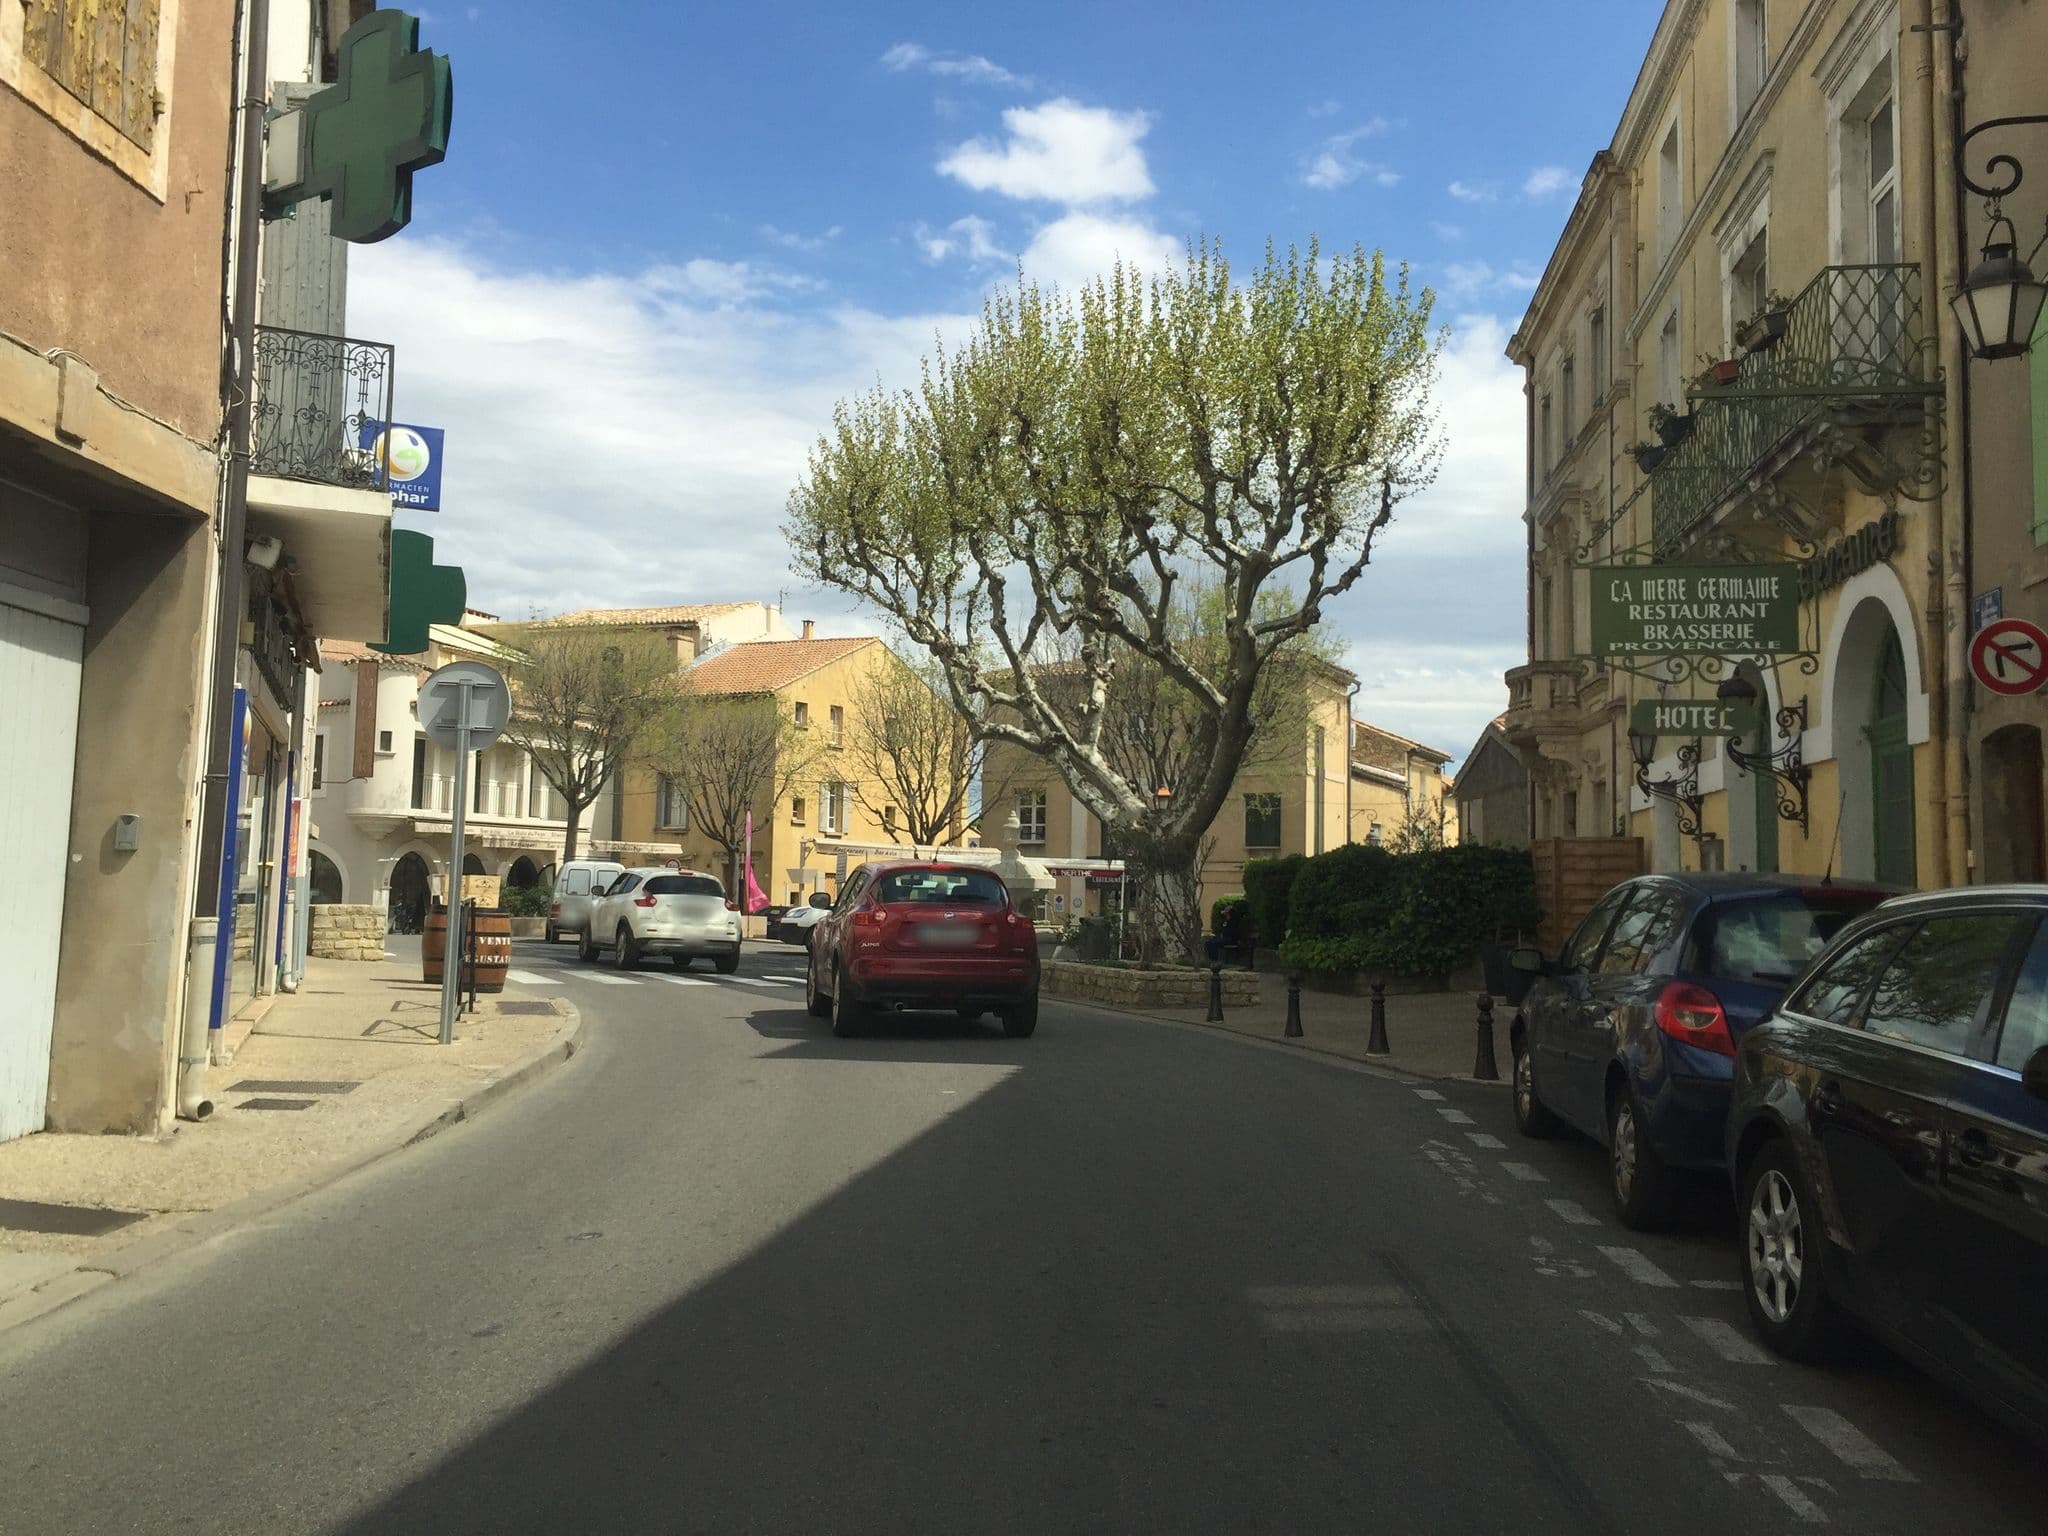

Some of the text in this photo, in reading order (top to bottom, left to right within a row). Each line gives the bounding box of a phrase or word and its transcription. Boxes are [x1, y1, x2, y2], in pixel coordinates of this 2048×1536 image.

[1611, 577, 1780, 601] LA MERE GERMAINE
[1629, 603, 1769, 620] RESTAURANT
[1643, 624, 1754, 640] BRASSERIE
[1609, 640, 1781, 651] PROVENCALE
[1655, 706, 1736, 730] HOTEL
